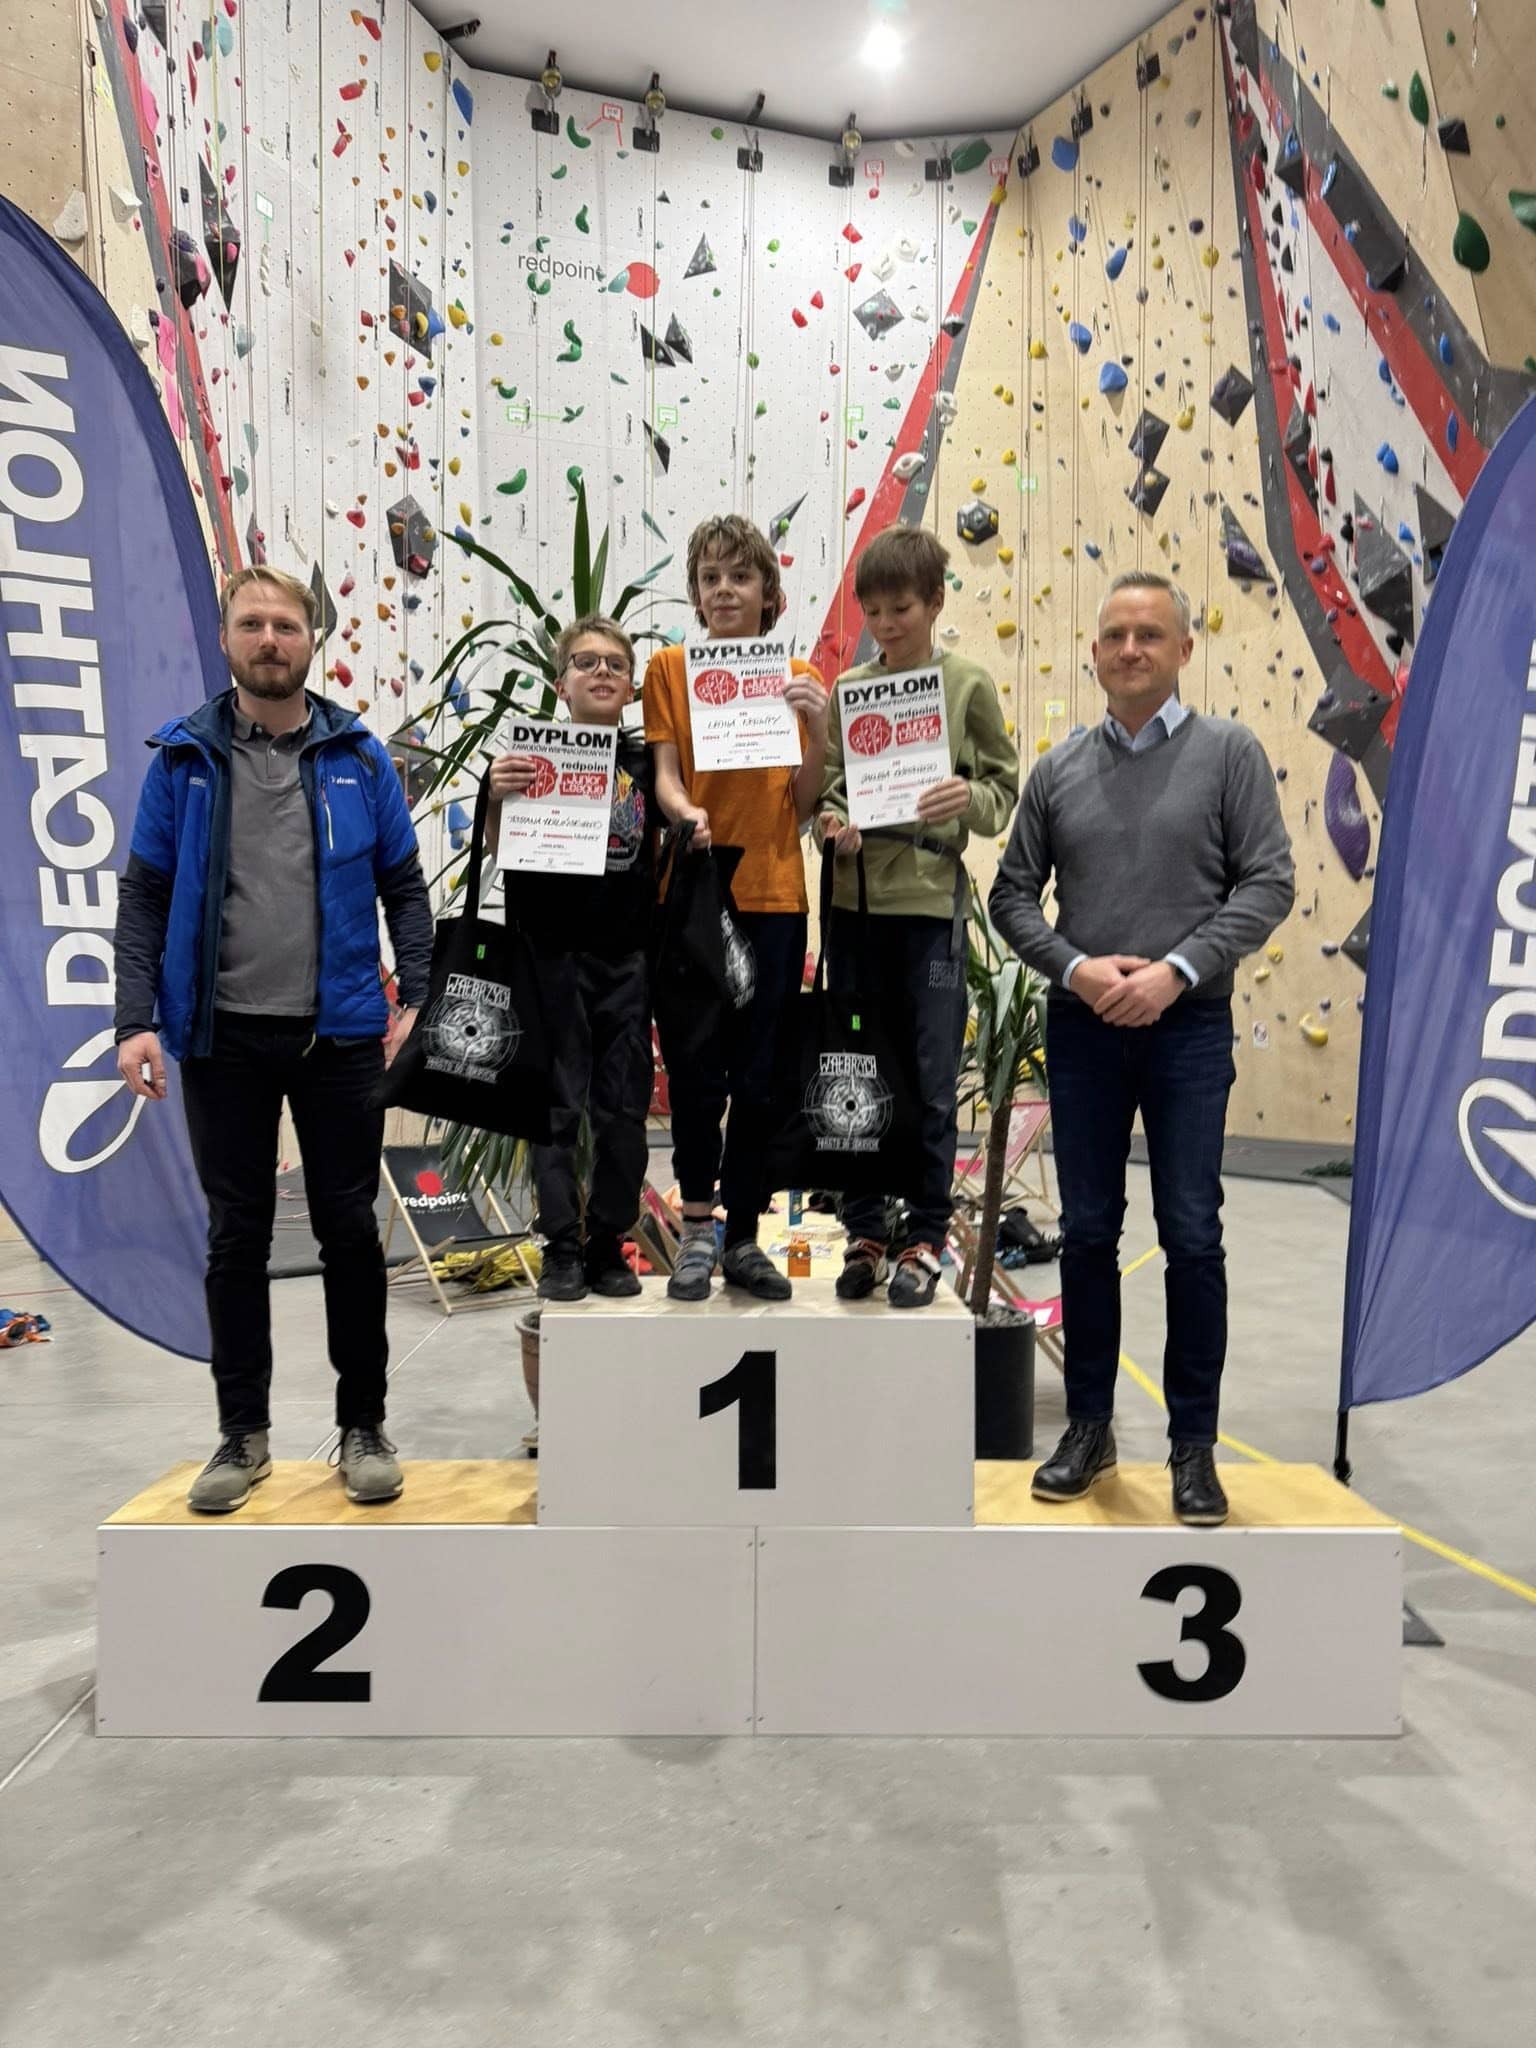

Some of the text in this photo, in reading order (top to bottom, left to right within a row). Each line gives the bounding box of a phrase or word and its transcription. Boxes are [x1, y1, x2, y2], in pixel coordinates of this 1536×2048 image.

[0, 345, 118, 1007] DECATHLON
[689, 642, 785, 661] DYPLOM
[843, 673, 940, 707] DYPLOM
[512, 725, 612, 750] DYPLOM
[561, 760, 608, 772] redpoint
[700, 1351, 776, 1489] 1
[258, 1564, 371, 1703] 2
[1136, 1564, 1246, 1703] 3
